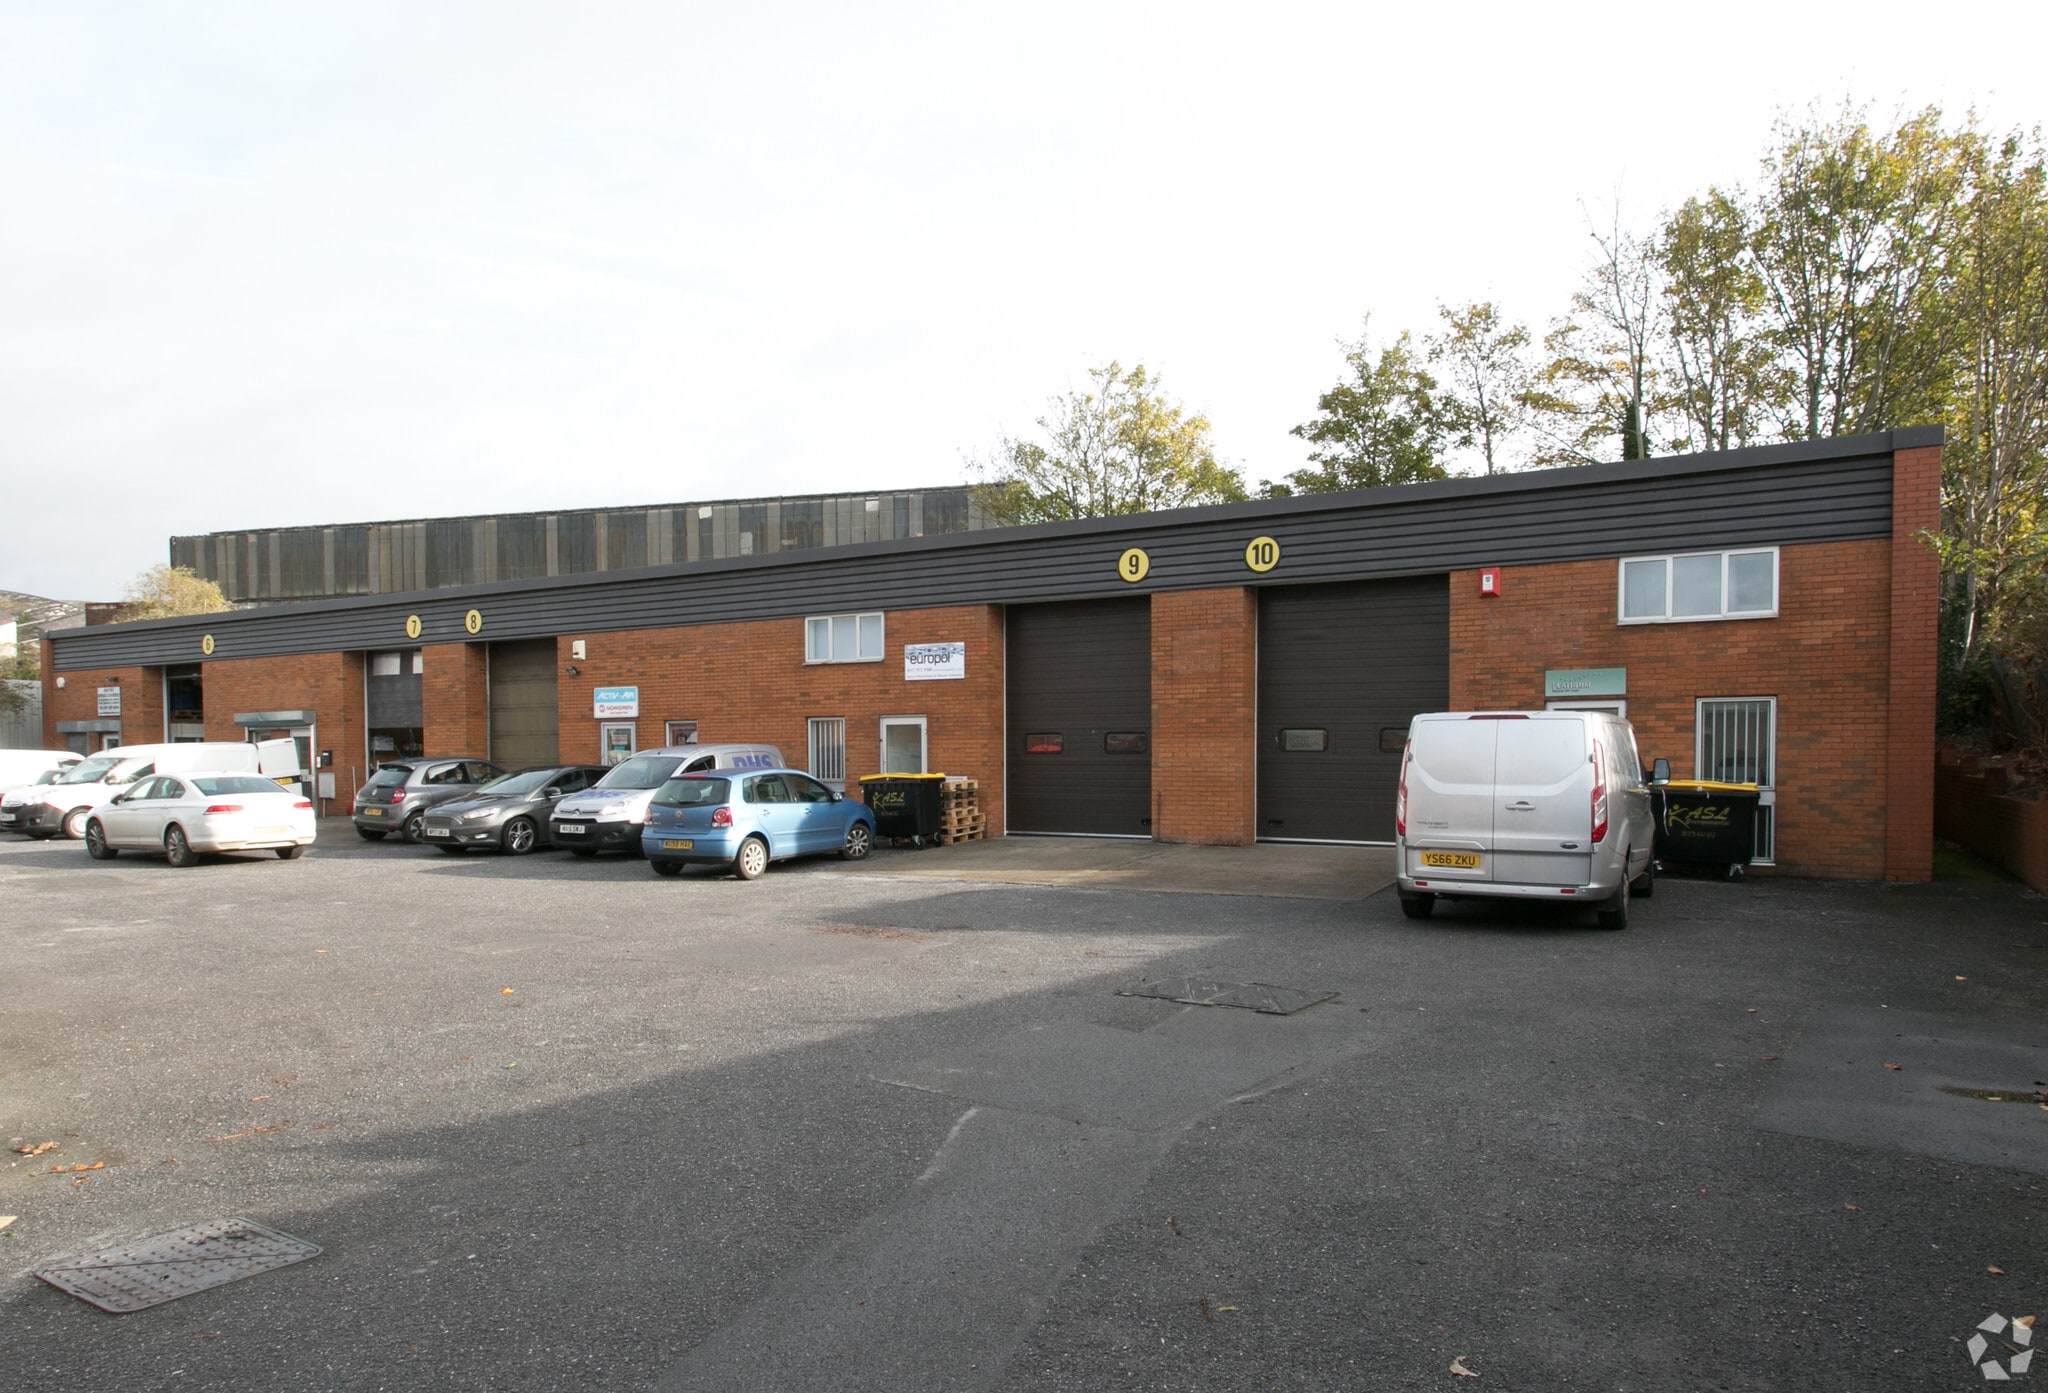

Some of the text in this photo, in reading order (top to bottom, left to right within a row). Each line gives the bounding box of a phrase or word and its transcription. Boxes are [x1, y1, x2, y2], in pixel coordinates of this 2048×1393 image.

[1252, 542, 1273, 565] 10
[1128, 554, 1139, 575] 9
[411, 620, 417, 635] 7
[470, 614, 477, 630] 8
[205, 638, 211, 651] 6
[910, 651, 951, 666] europol
[1425, 853, 1476, 866] YS66 ZKU
